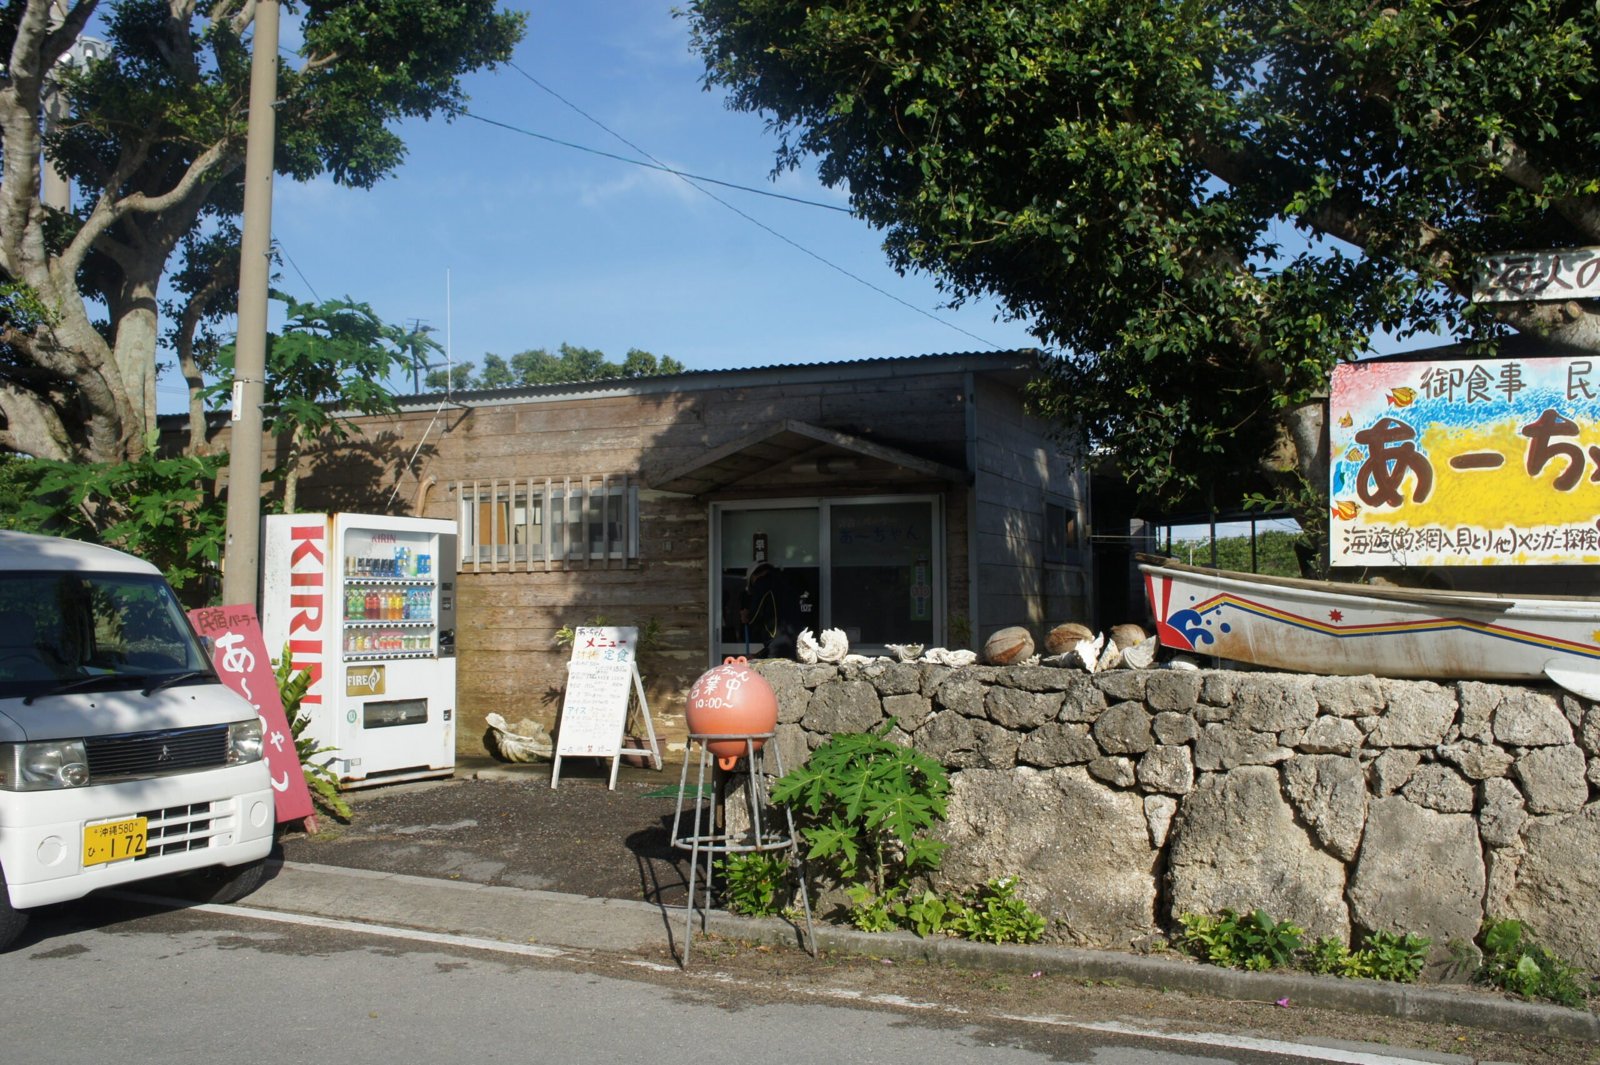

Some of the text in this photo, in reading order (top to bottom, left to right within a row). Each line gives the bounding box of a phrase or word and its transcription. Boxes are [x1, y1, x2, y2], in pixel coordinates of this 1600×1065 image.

[1420, 361, 1527, 403] 御食事
[1355, 409, 1600, 508] あーち
[371, 533, 397, 544] KIRIN
[585, 637, 628, 648] メニュー
[604, 649, 630, 663] 定食
[347, 674, 370, 687] FIRE
